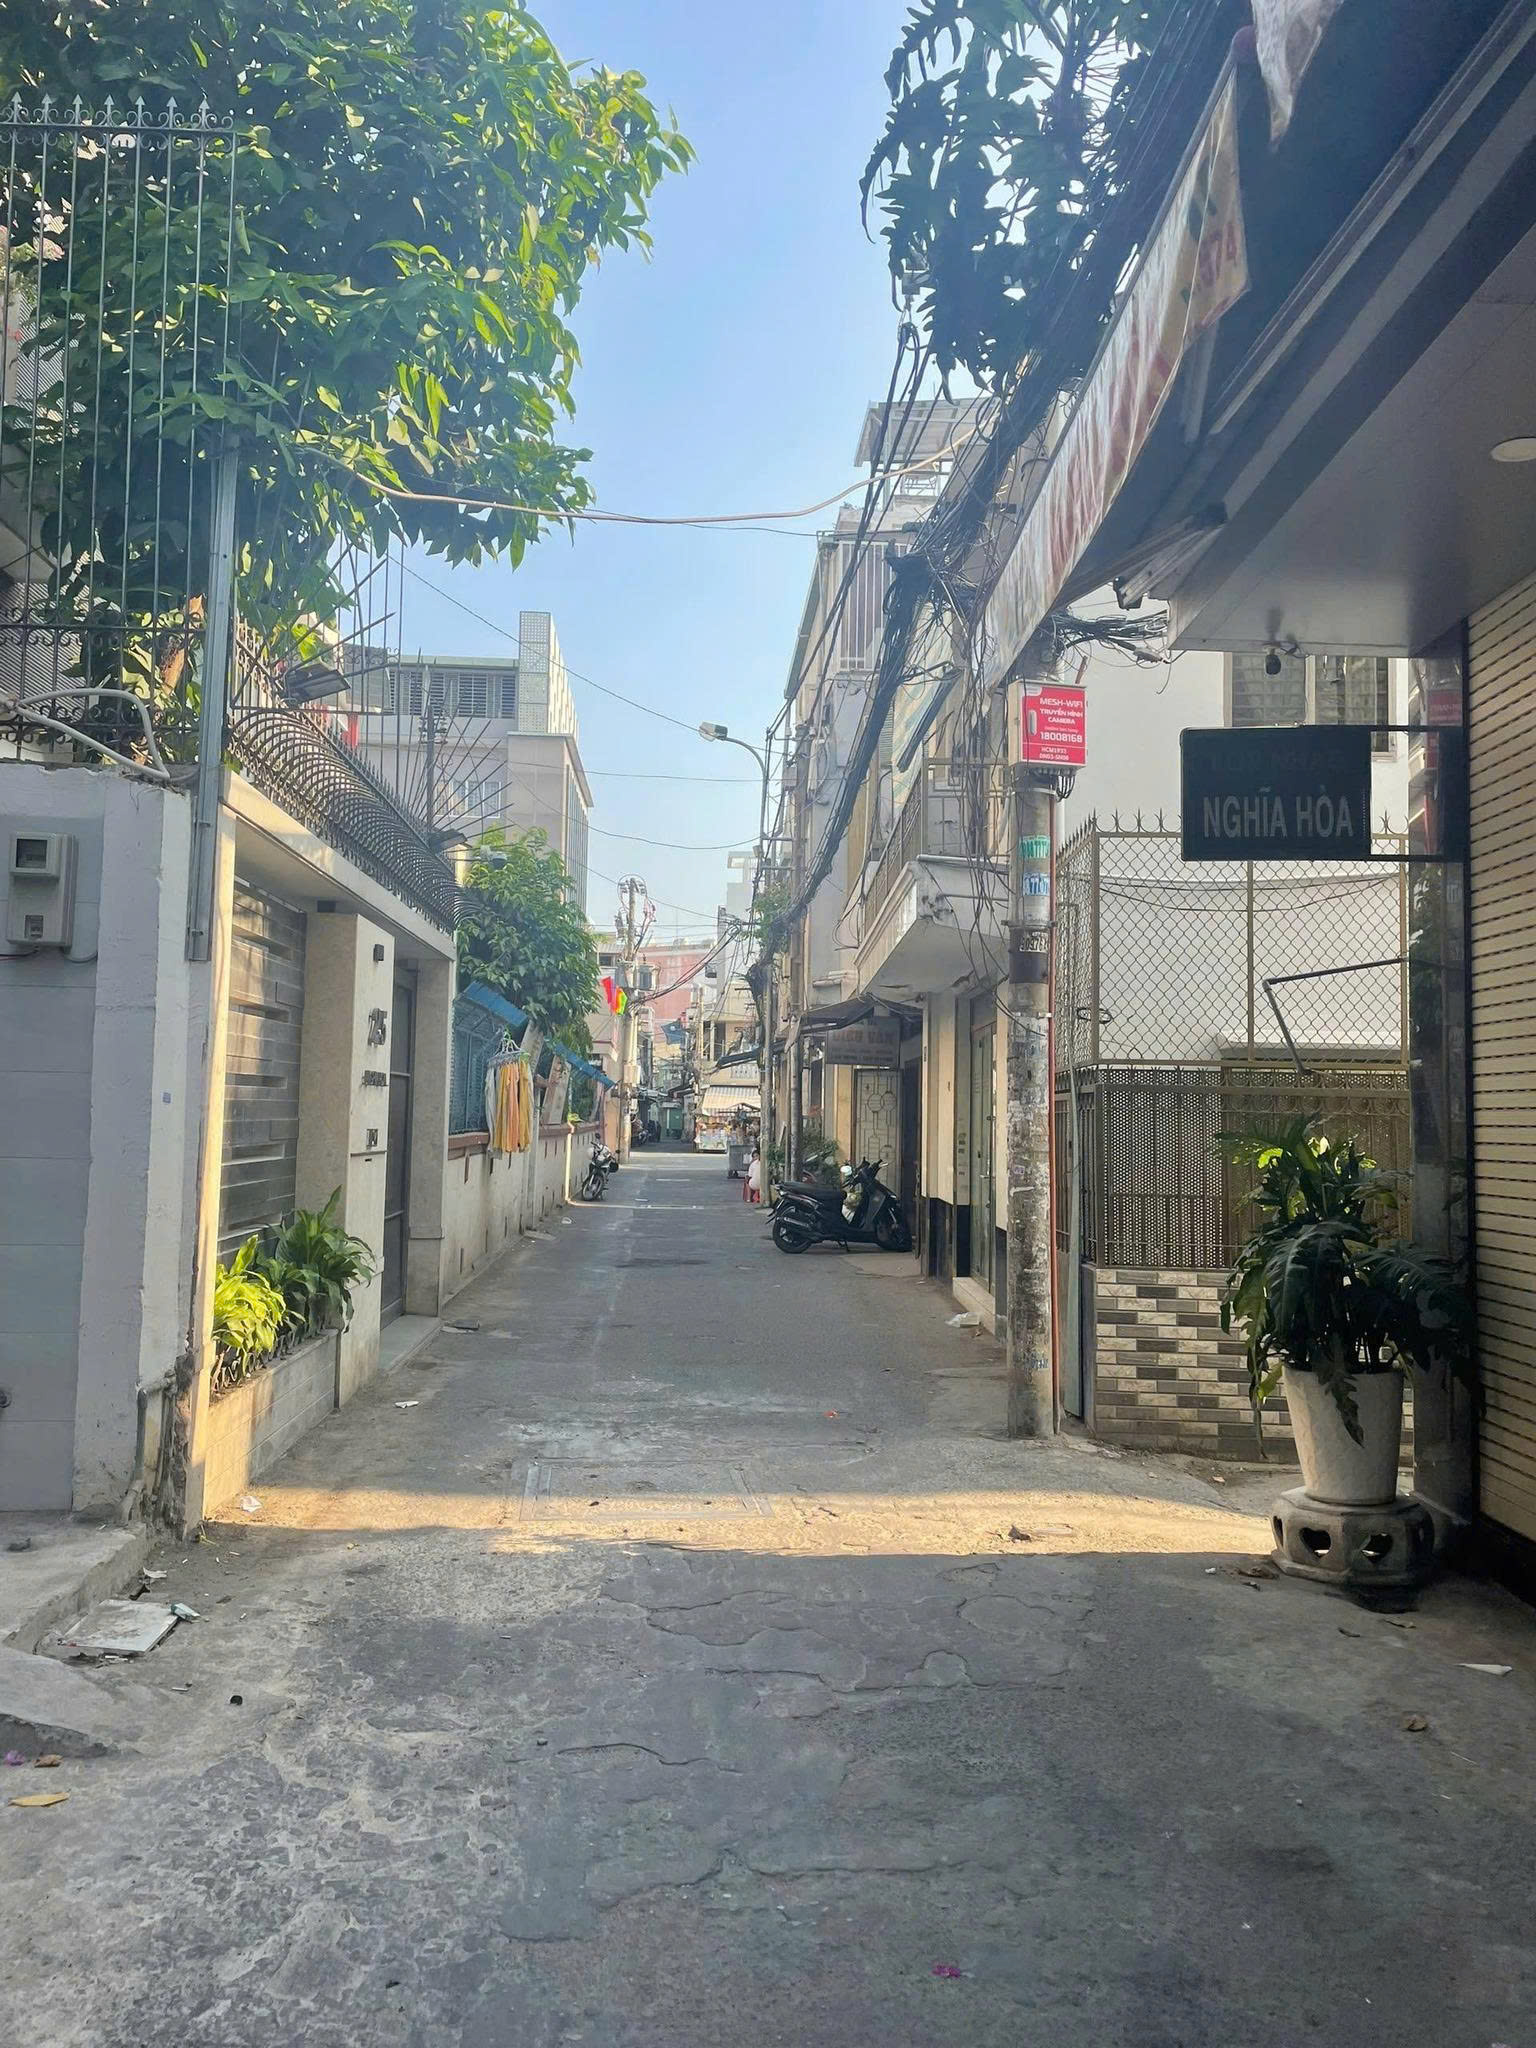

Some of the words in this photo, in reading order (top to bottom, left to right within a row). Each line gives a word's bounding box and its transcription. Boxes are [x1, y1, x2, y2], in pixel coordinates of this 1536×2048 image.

[1040, 698, 1083, 708] MESH-WIFI
[1048, 717, 1075, 725] CAMERA
[1202, 785, 1288, 838] NGHĨA
[1295, 783, 1354, 838] HÒA
